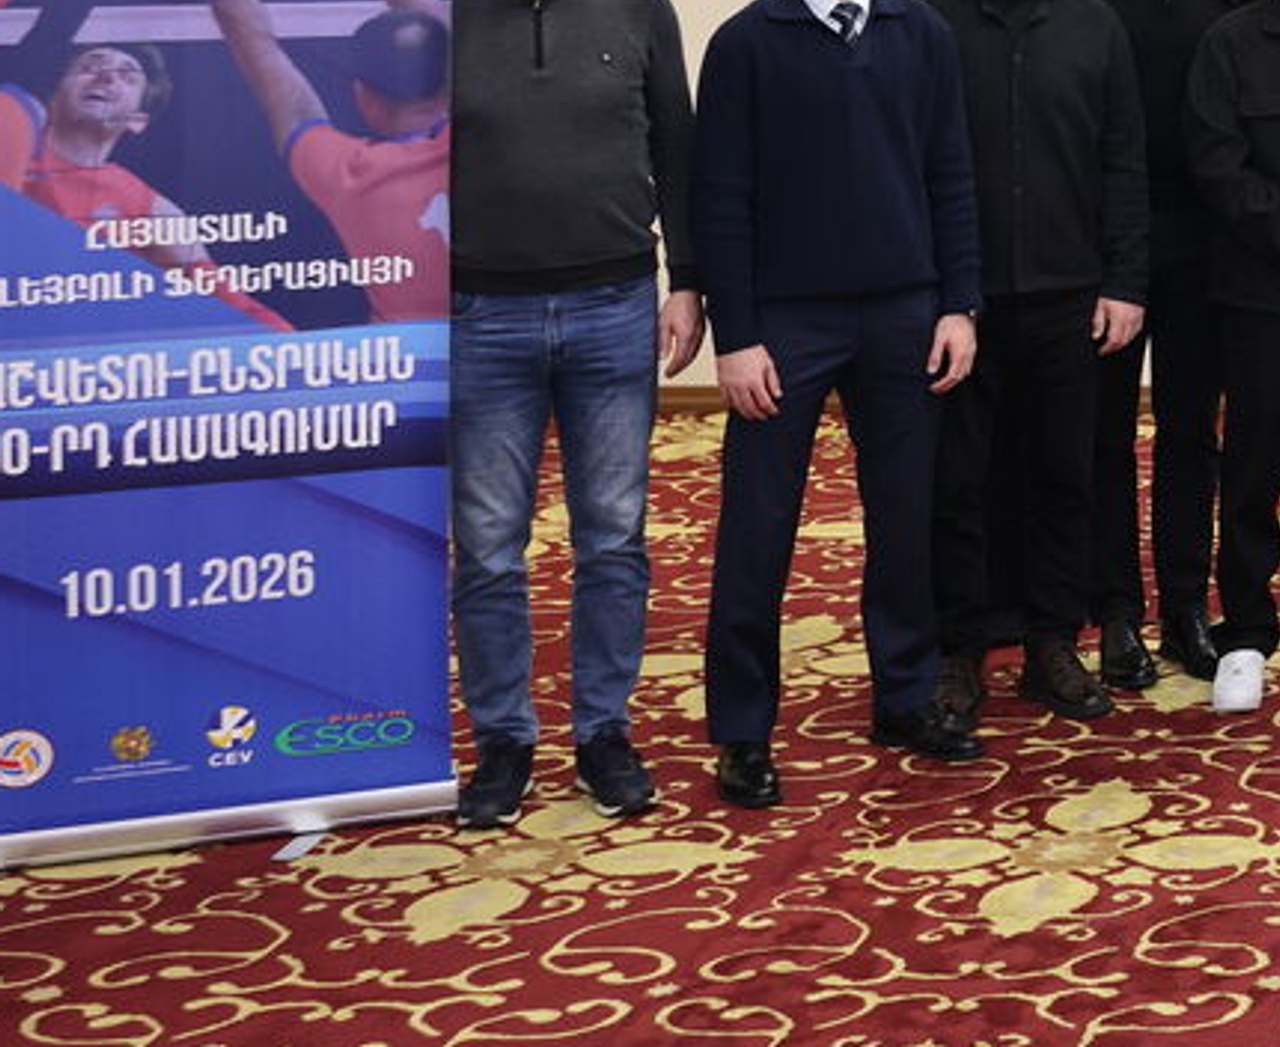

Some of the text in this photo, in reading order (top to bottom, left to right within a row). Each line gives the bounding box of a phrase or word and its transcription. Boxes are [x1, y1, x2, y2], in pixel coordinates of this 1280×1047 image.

[85, 211, 288, 250] ՀԱՅԱՍՏԱՆԻ
[122, 399, 398, 467] ՀԱՄԱԳՈՒՄԱՐ
[60, 549, 317, 619] 10.01.2026
[207, 716, 416, 768] CEV ESCO
